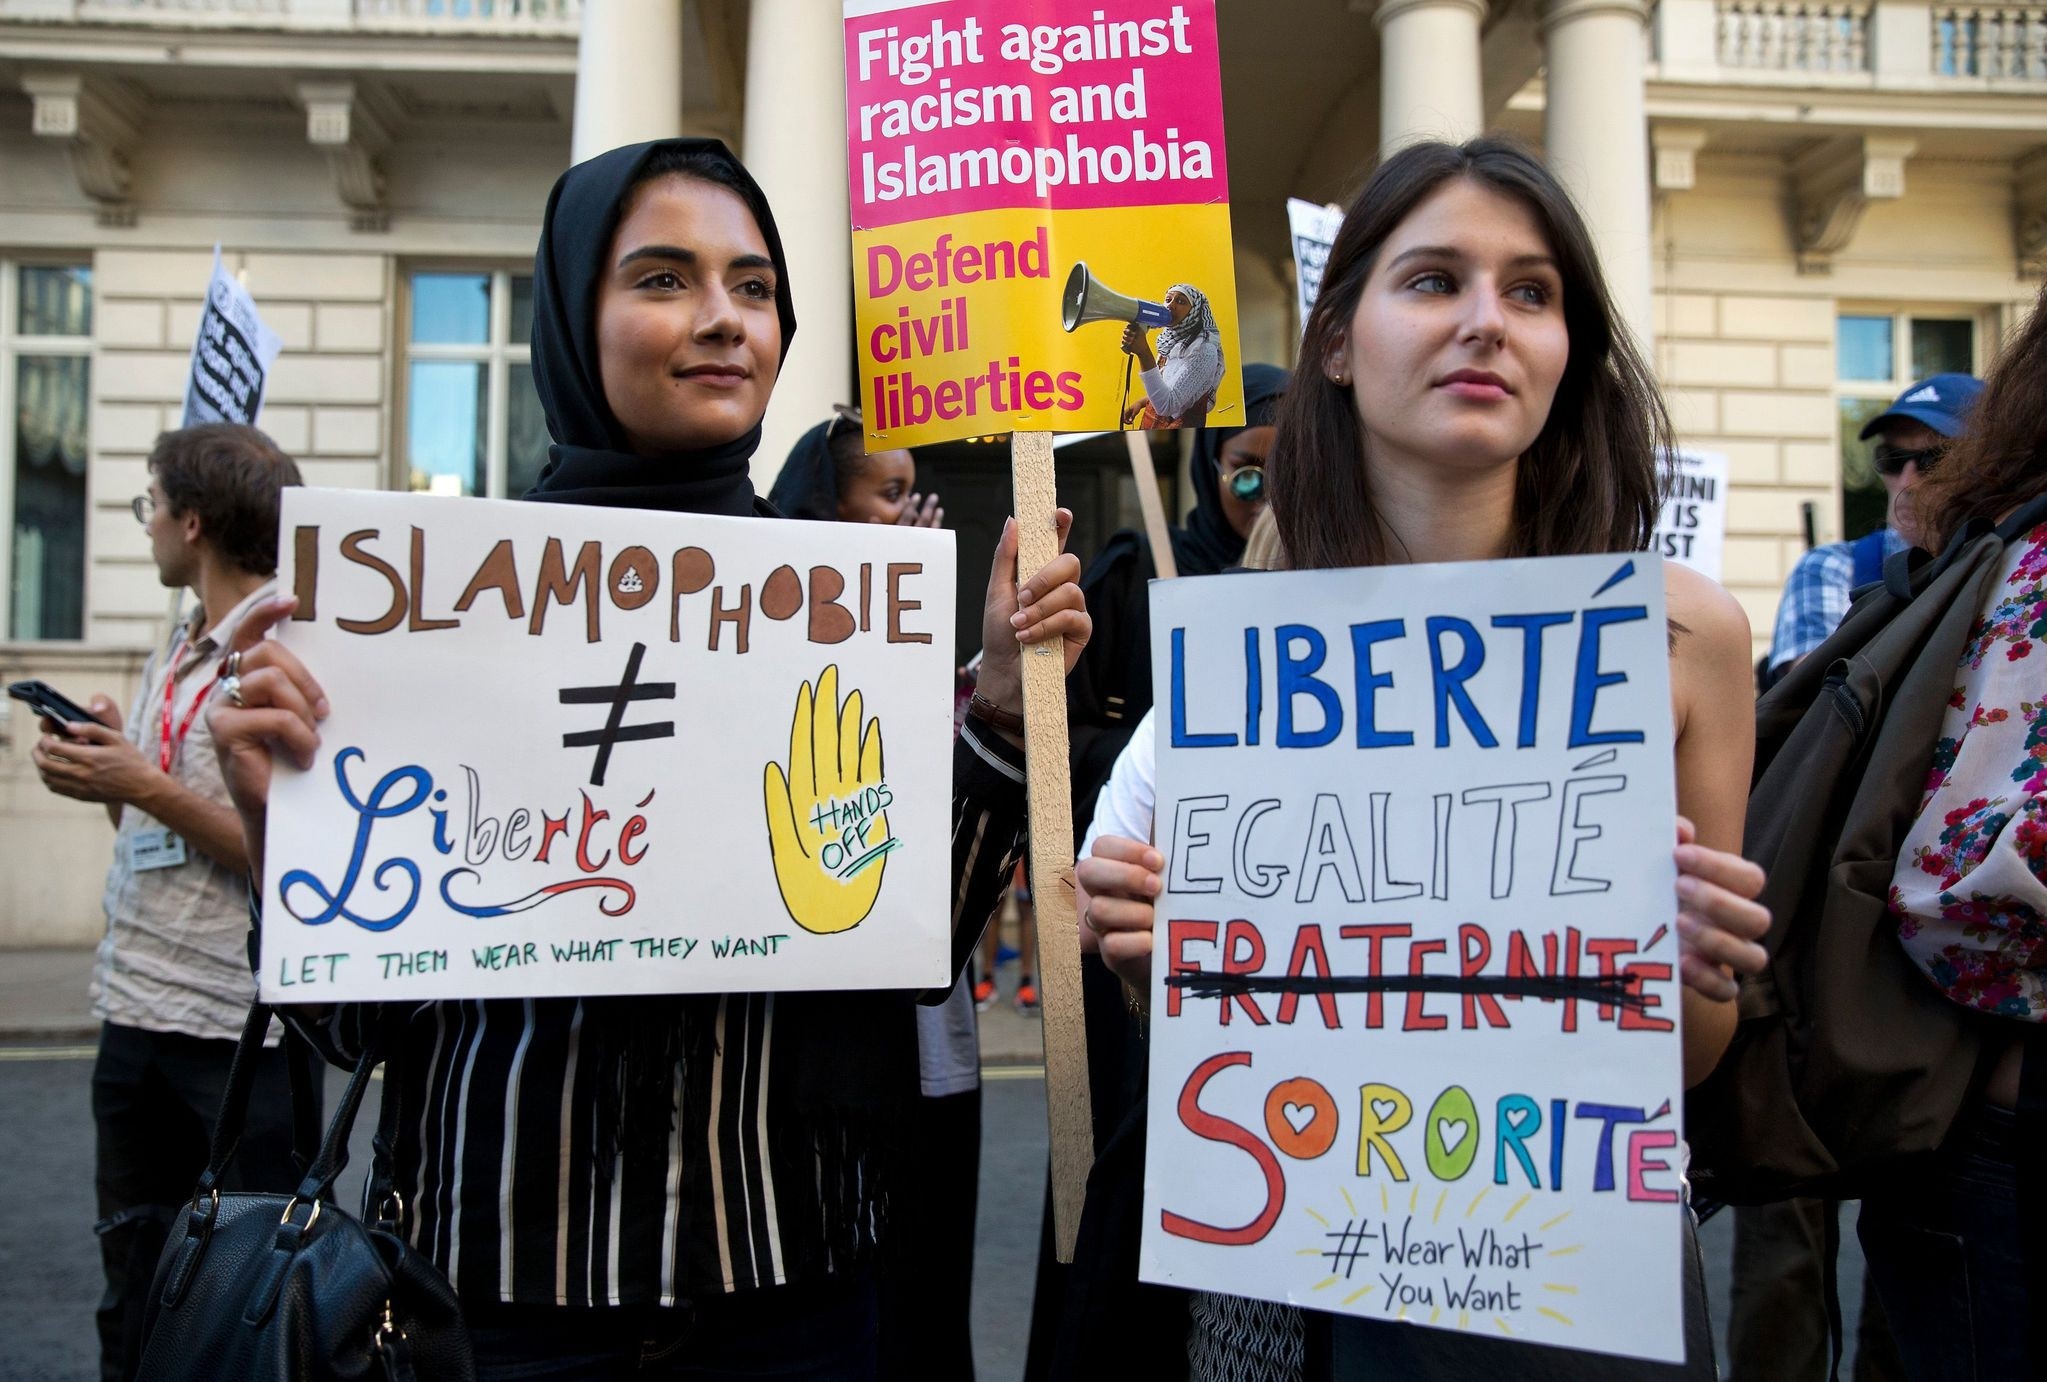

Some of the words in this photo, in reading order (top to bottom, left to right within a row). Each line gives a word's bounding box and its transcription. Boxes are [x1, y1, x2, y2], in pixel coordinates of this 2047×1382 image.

[858, 17, 985, 85] Fight
[1000, 5, 1192, 75] against
[859, 79, 1032, 142] racism
[1049, 68, 1147, 124] and
[862, 127, 1213, 204] Islamophobia
[867, 226, 1050, 299] Defend
[870, 296, 969, 364] civil
[874, 356, 1084, 431] liberties
[1675, 503, 1699, 528] IS
[291, 525, 932, 654] ISLAMOPHOBIE
[1170, 560, 1648, 750] LIBERTÉ
[279, 746, 656, 932] Liberté
[810, 783, 894, 835] HANDS
[822, 816, 872, 870] OFF
[1167, 748, 1627, 903] EGALITÉ
[280, 953, 351, 987] LET
[376, 949, 448, 980] THEM
[472, 941, 537, 970] WEAR
[550, 938, 624, 965] WHAT
[629, 936, 698, 960] THEY
[711, 934, 791, 958] WANT
[1166, 919, 1675, 1032] FRATERNITÉ
[1161, 1052, 1679, 1246] SORORITÉ
[1380, 1272, 1433, 1312] You
[1444, 1276, 1521, 1312] Want
